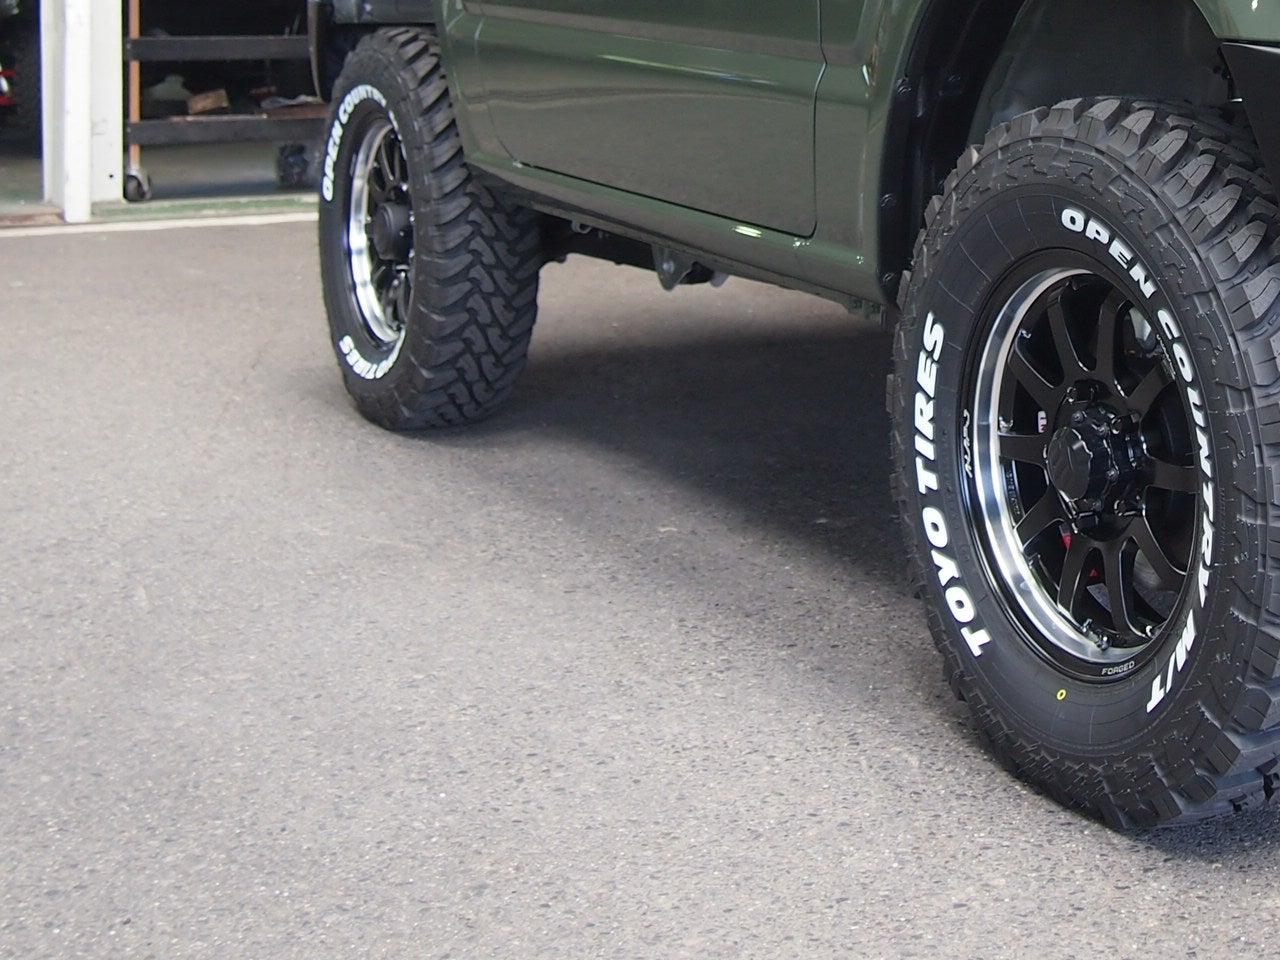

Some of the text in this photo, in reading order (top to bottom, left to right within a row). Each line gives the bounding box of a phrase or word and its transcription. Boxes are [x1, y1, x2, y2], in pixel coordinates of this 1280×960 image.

[322, 119, 344, 202] OPEN
[914, 311, 992, 658] TOYO TIRES
[1061, 208, 1214, 714] OPEN COUNTRY M/T
[1101, 660, 1135, 675] FORGED
